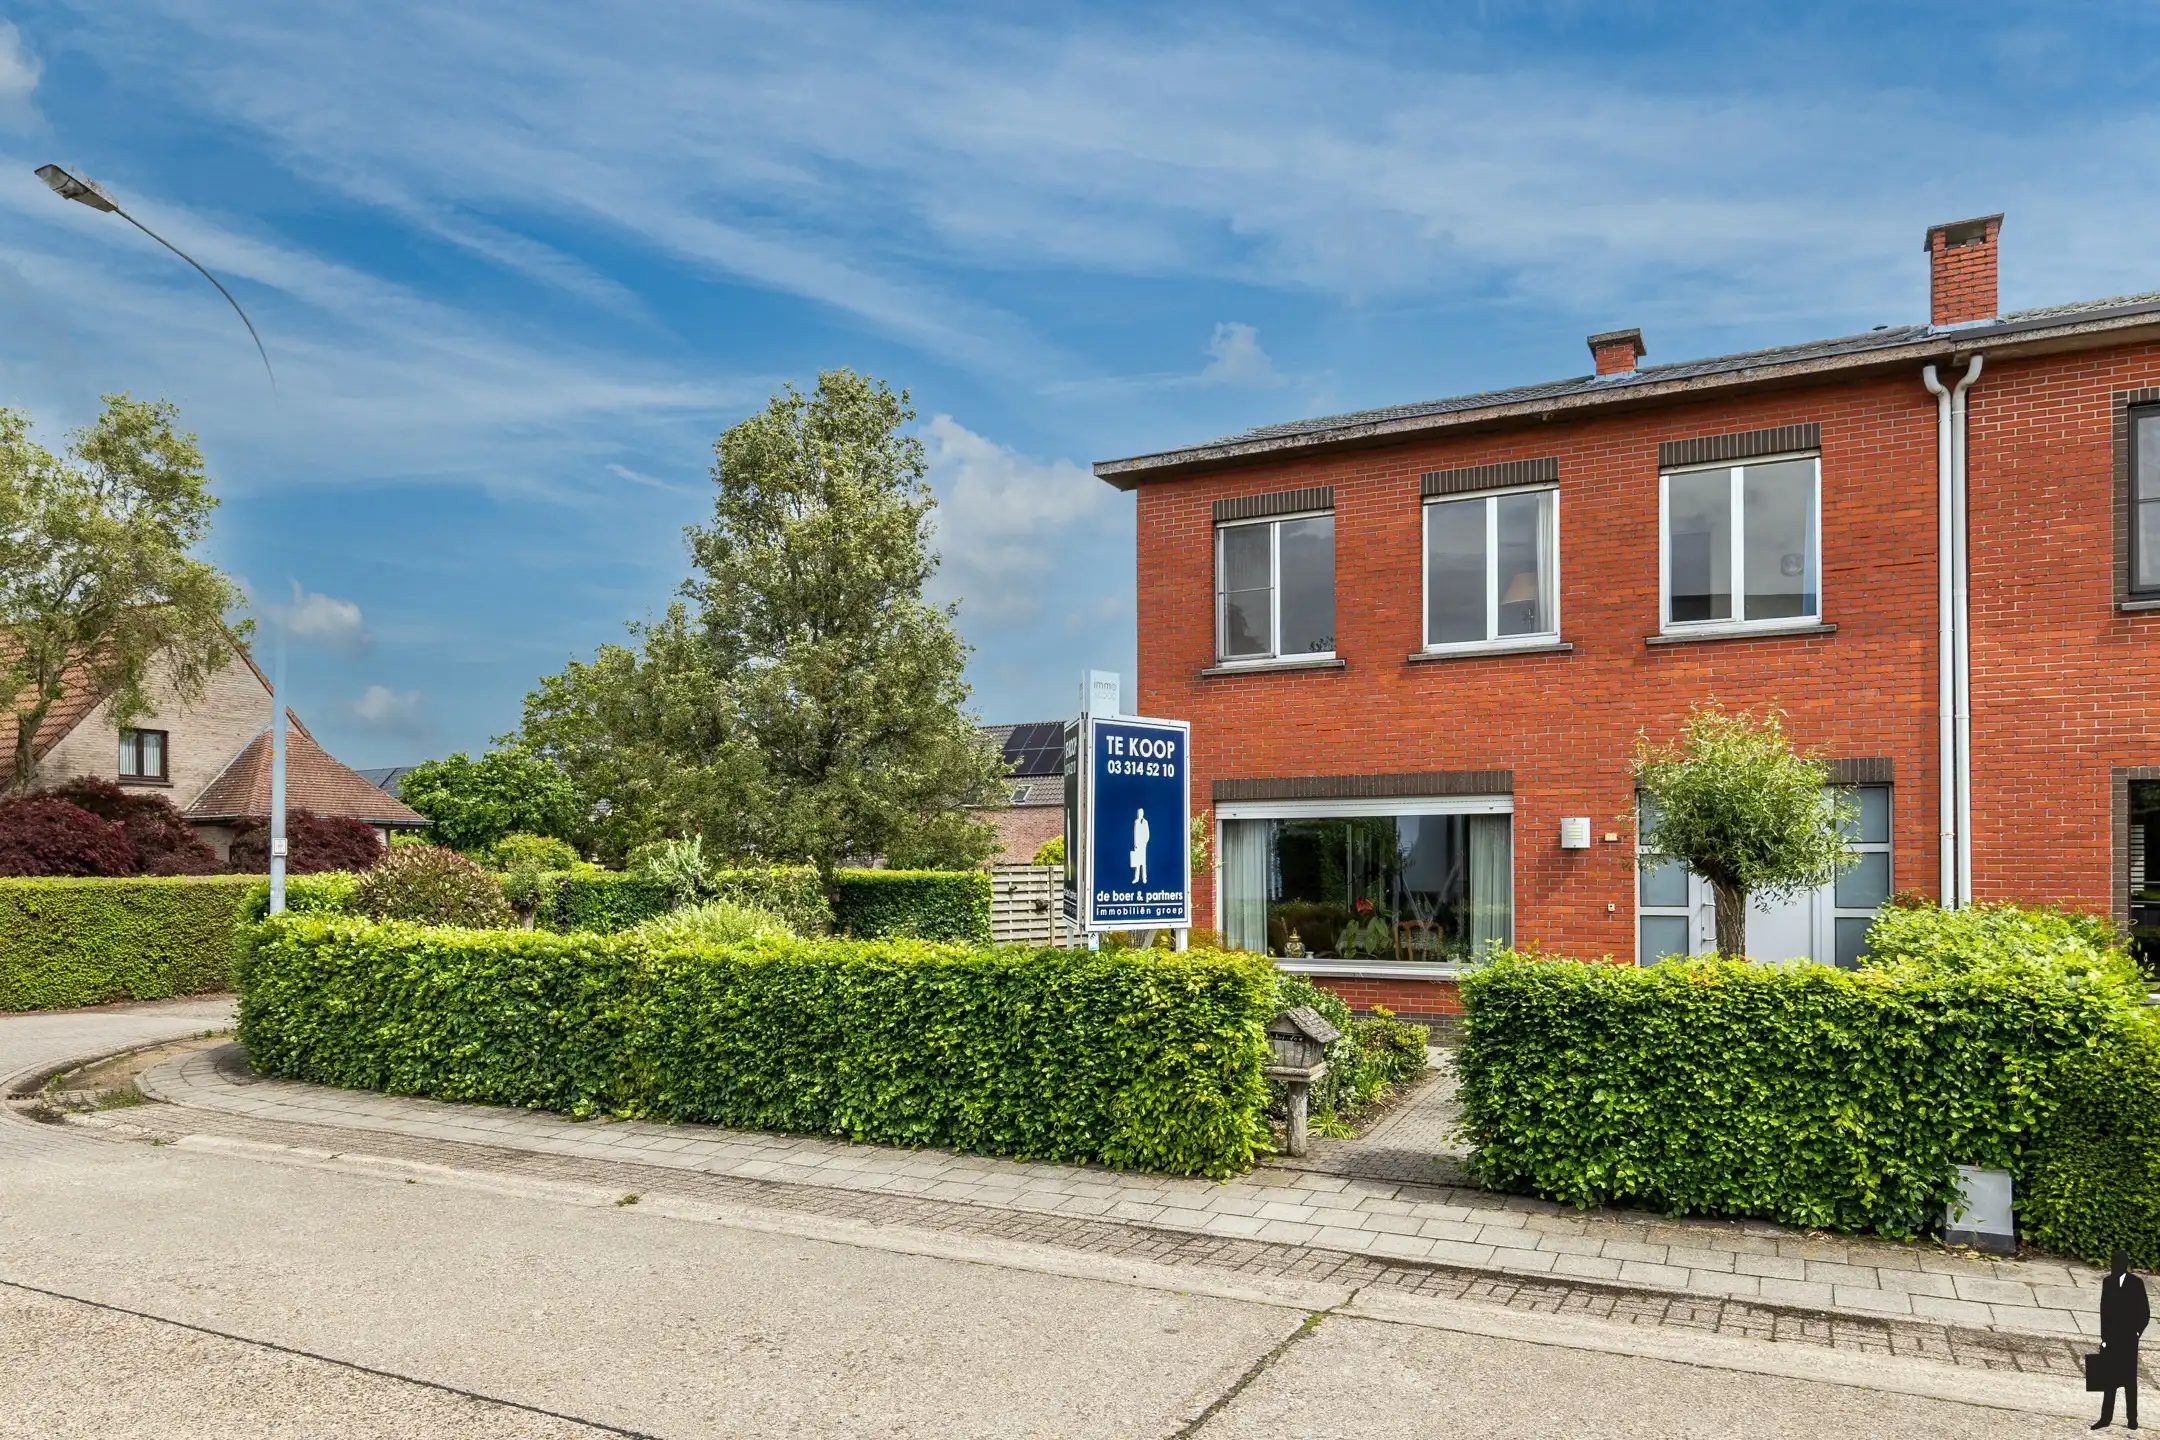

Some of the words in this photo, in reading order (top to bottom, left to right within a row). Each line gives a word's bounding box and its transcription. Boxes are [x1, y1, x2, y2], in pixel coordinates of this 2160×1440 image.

[1106, 735, 1123, 755] TE
[1129, 737, 1175, 759] KOOP
[1107, 760, 1121, 774] 03
[1124, 761, 1144, 775] 314
[1146, 762, 1160, 776] 52
[1162, 763, 1175, 777] 10
[1096, 890, 1110, 902] de
[1112, 890, 1134, 902] boer
[1136, 890, 1144, 902] &
[1146, 890, 1183, 903] partners
[1096, 906, 1151, 916] immobiliën
[1156, 907, 1183, 916] groep
